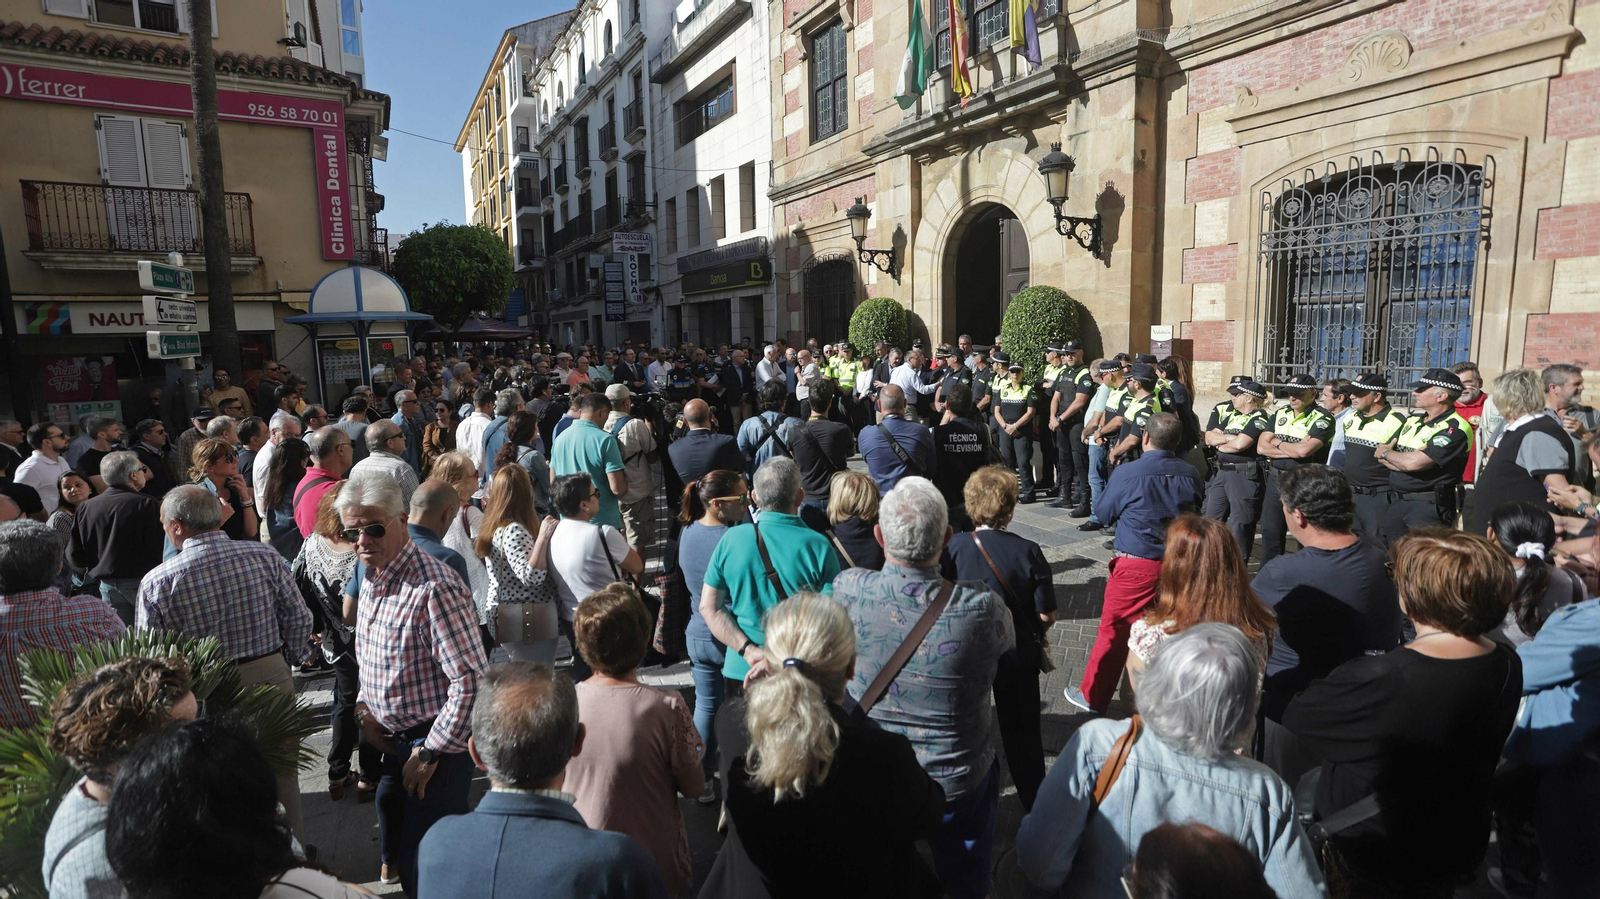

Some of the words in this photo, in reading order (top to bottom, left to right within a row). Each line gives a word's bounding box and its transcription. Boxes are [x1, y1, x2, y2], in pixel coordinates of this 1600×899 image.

[18, 67, 86, 98] ferrer
[247, 102, 275, 117] 956
[279, 106, 297, 120] 58
[301, 108, 319, 122] 70
[322, 110, 338, 124] 01
[322, 134, 340, 190] Dental
[329, 195, 345, 254] Clinica
[614, 233, 649, 241] AUTOESCUELA
[152, 271, 164, 282] Plaza
[164, 273, 174, 283] Alta
[629, 254, 638, 294] ROCHA
[709, 273, 727, 285] Bankia
[88, 312, 147, 327] NAUT
[948, 432, 978, 443] TÉCNICO
[943, 442, 983, 453] TELEVISIÓN
